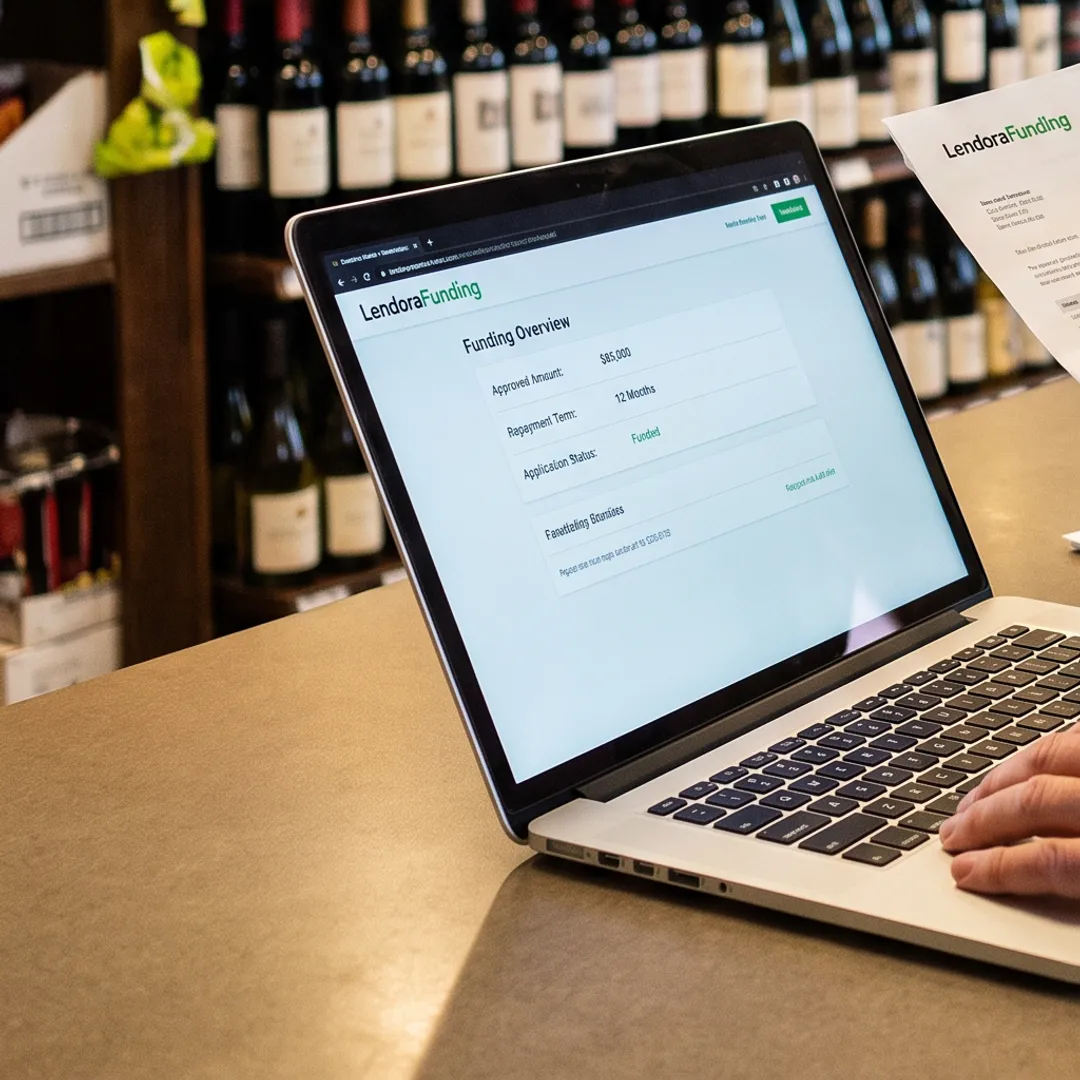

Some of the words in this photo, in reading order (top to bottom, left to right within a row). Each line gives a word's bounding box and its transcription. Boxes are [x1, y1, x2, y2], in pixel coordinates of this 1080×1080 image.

[359, 280, 483, 322] LendoraFunding
[463, 325, 515, 354] Funding
[515, 315, 571, 340] Overview
[599, 347, 632, 365] $85,000
[492, 375, 531, 397] Approved
[615, 392, 627, 403] 12
[552, 409, 578, 425] Term:
